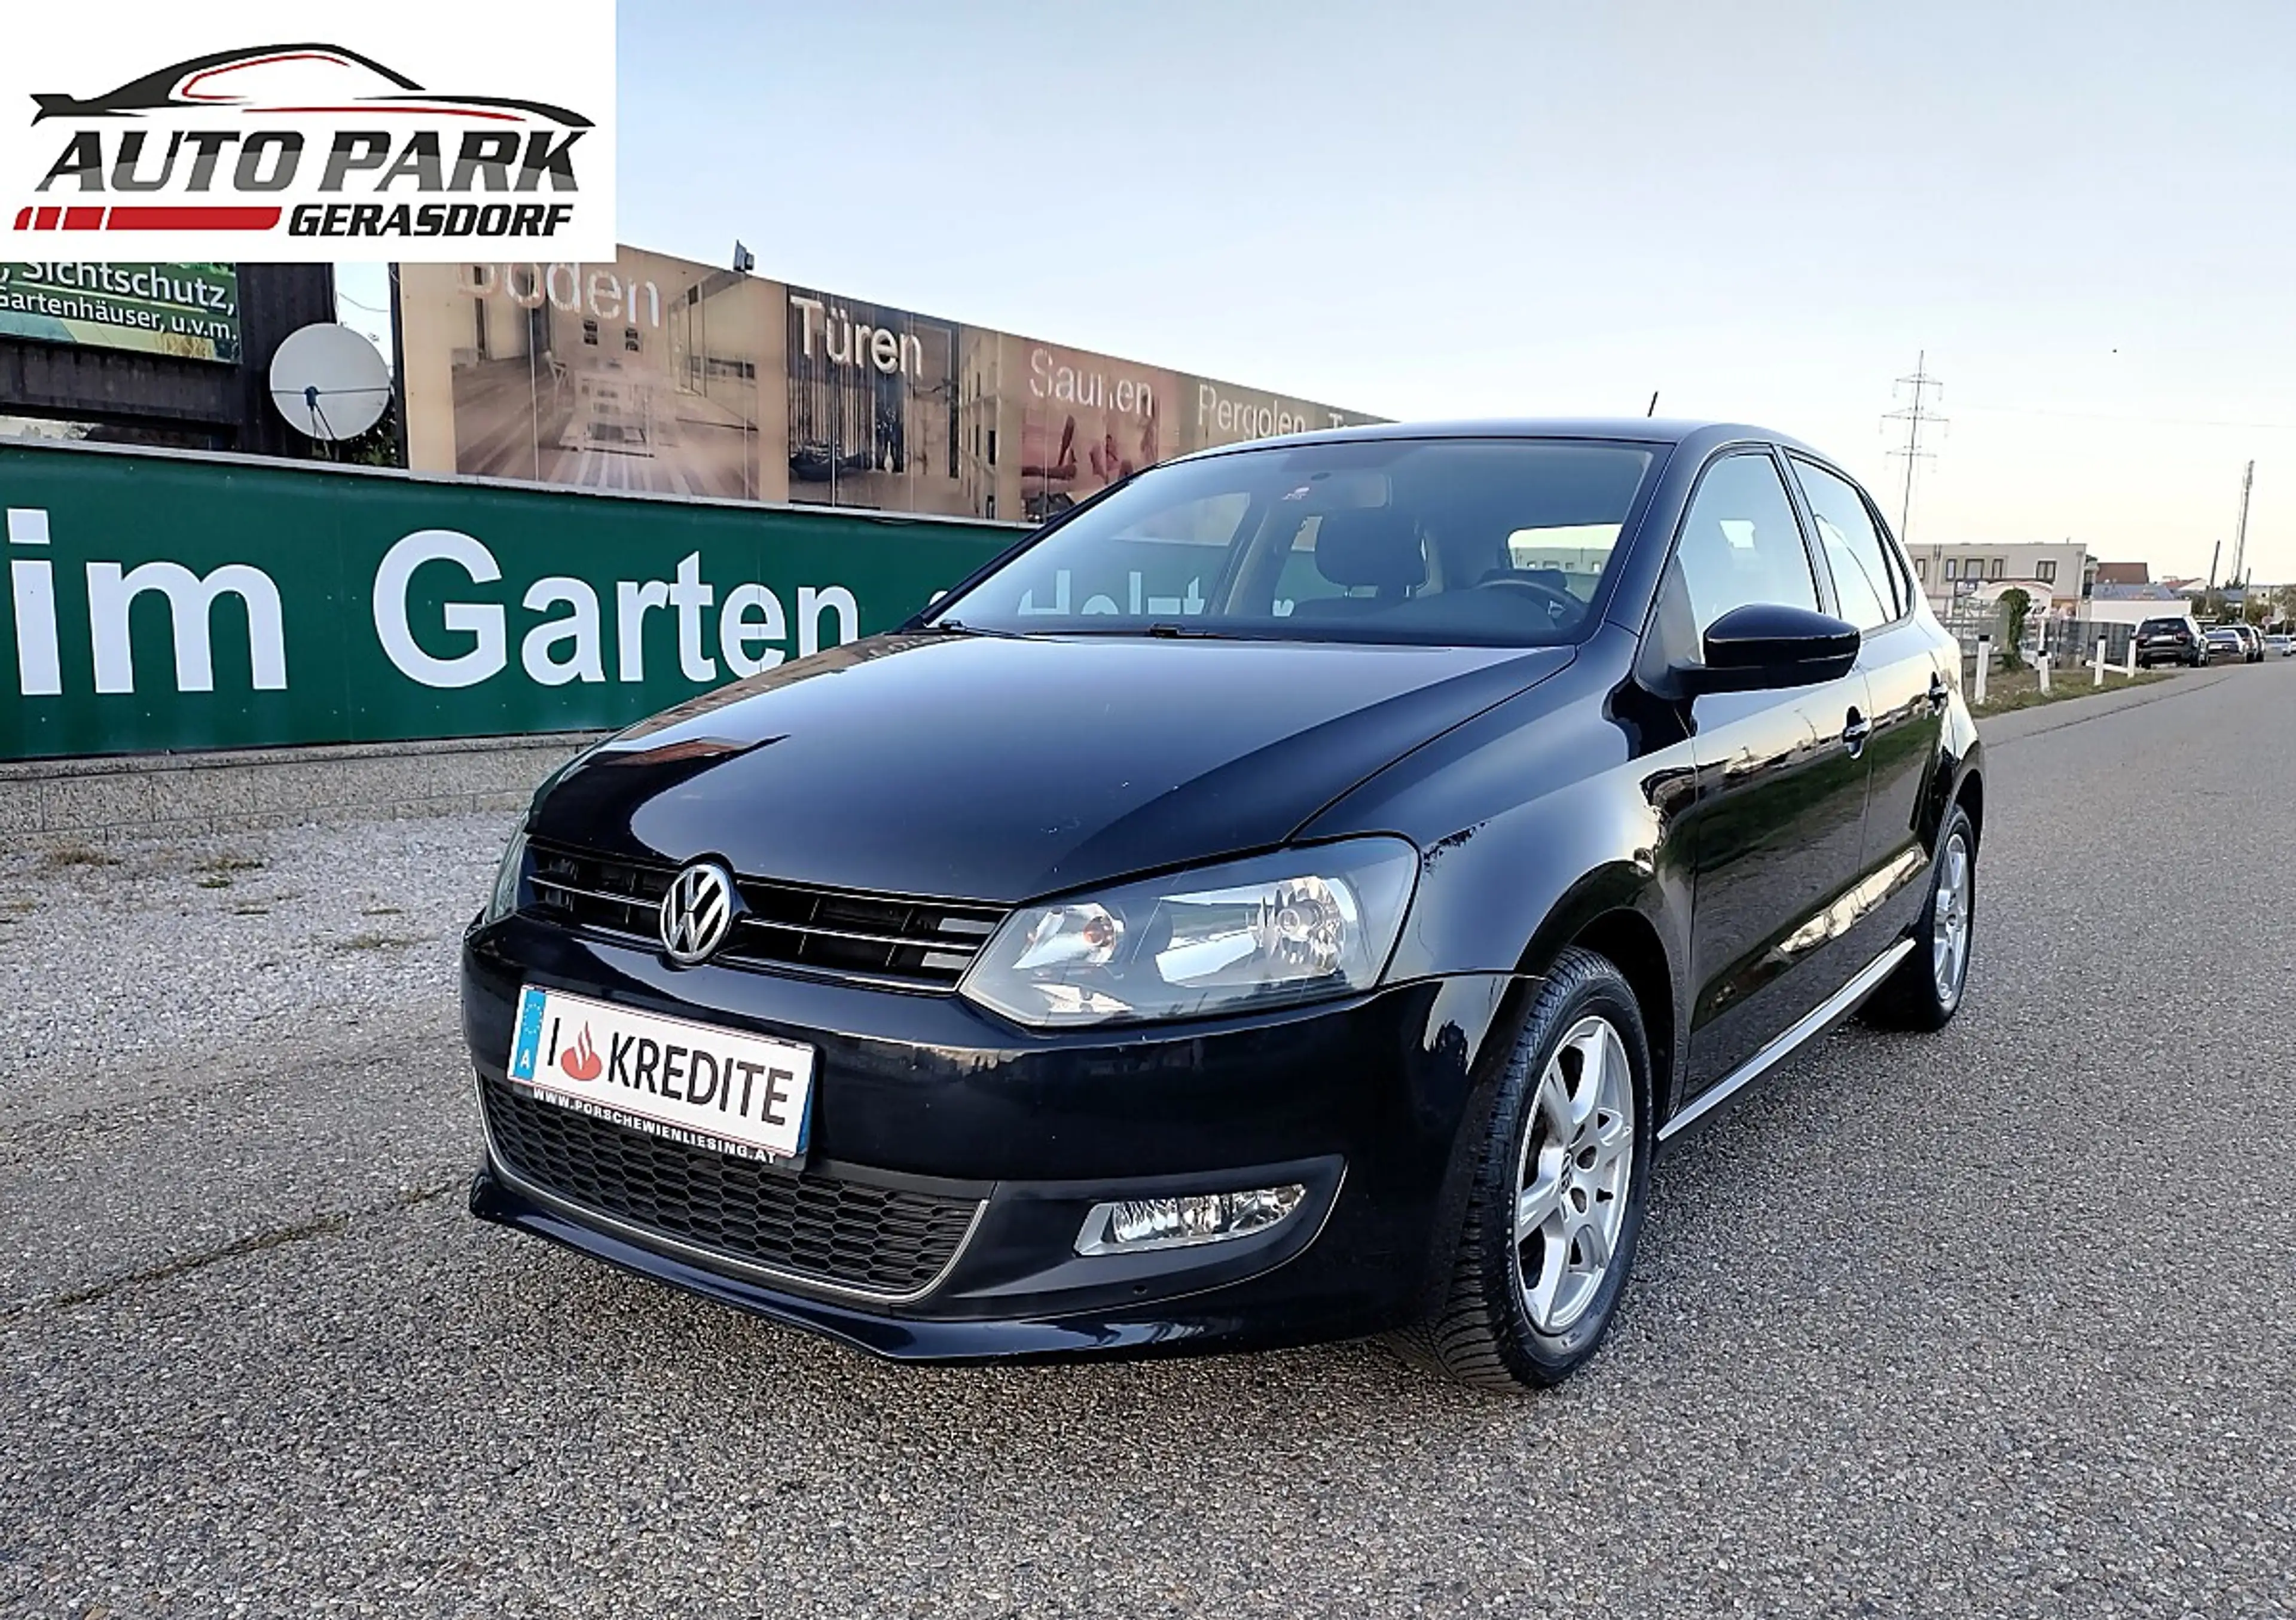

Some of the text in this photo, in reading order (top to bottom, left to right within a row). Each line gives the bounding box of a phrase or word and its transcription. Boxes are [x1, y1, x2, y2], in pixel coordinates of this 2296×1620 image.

[171, 316, 237, 341] u.v.m.
[790, 295, 923, 378] Türen
[7, 508, 859, 695] im Garten
[547, 1017, 793, 1126] I KREDITE
[533, 1087, 775, 1164] WWW.PORSCHEWIENLIESING.AT
